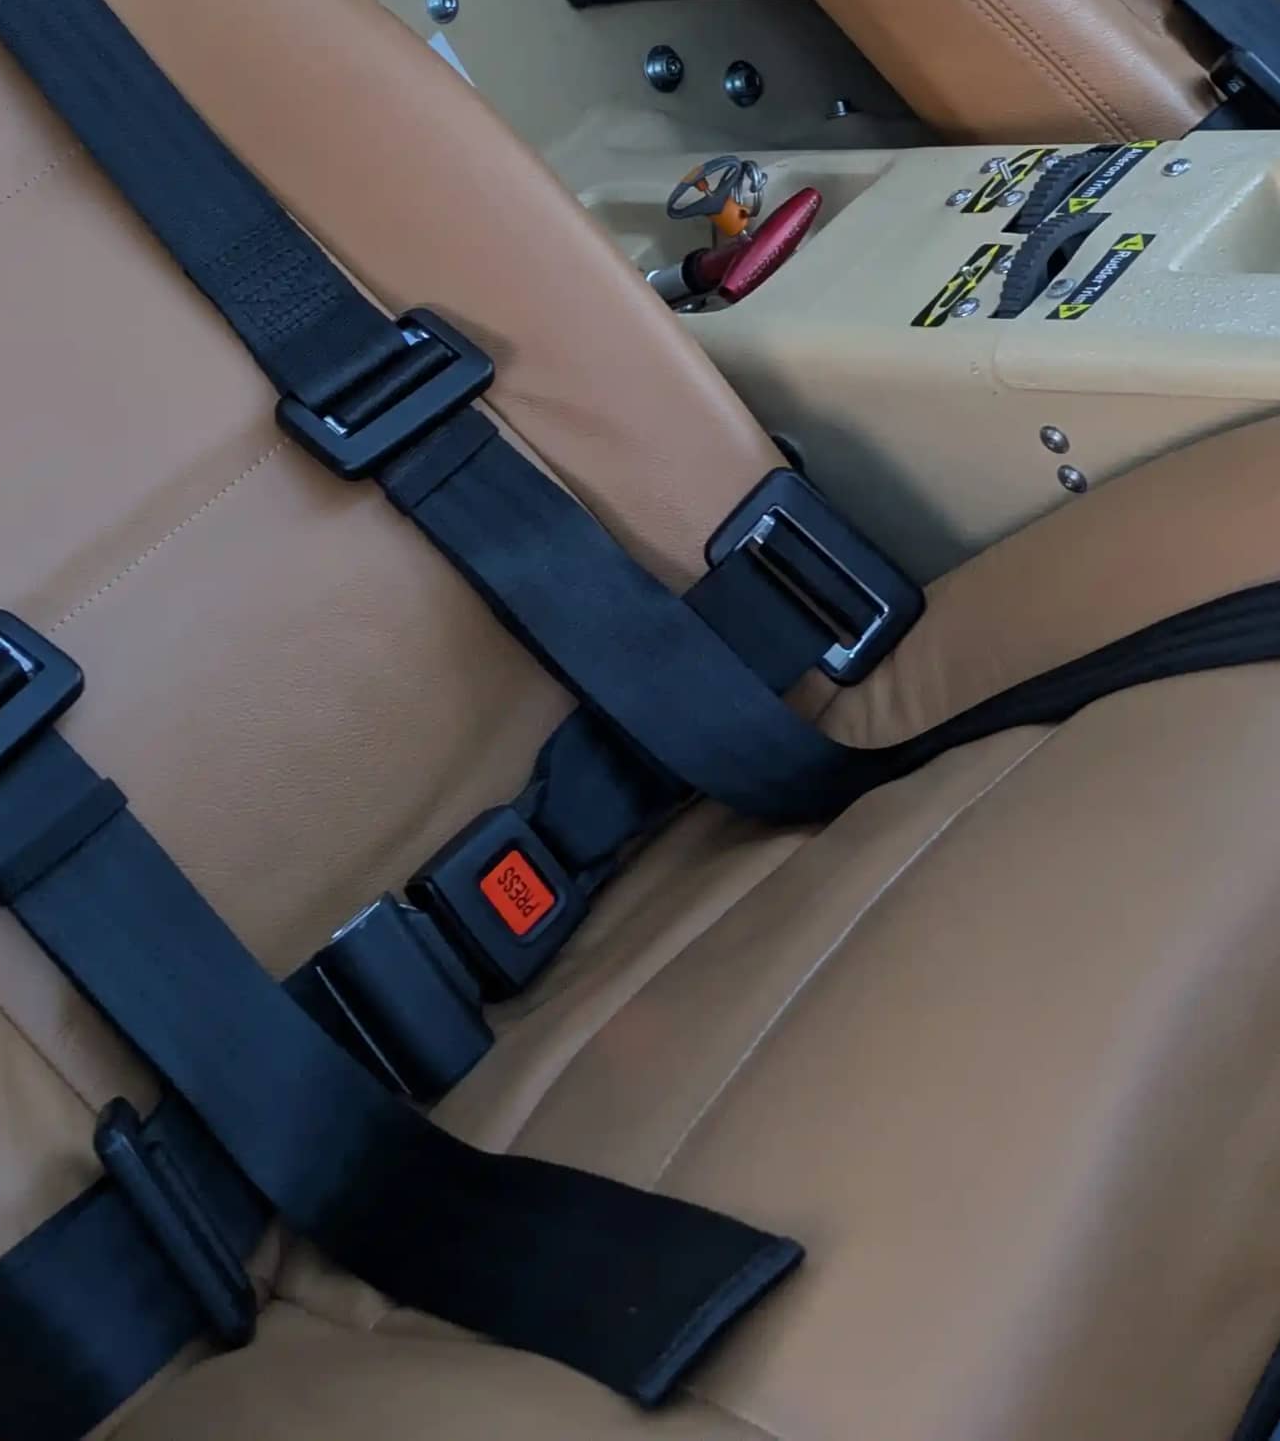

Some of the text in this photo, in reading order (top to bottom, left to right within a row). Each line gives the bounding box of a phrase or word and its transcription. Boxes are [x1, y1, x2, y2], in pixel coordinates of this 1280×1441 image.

[1081, 148, 1143, 198] Aileron Trim
[1092, 251, 1132, 283] Rudder
[496, 866, 540, 918] PRESS
